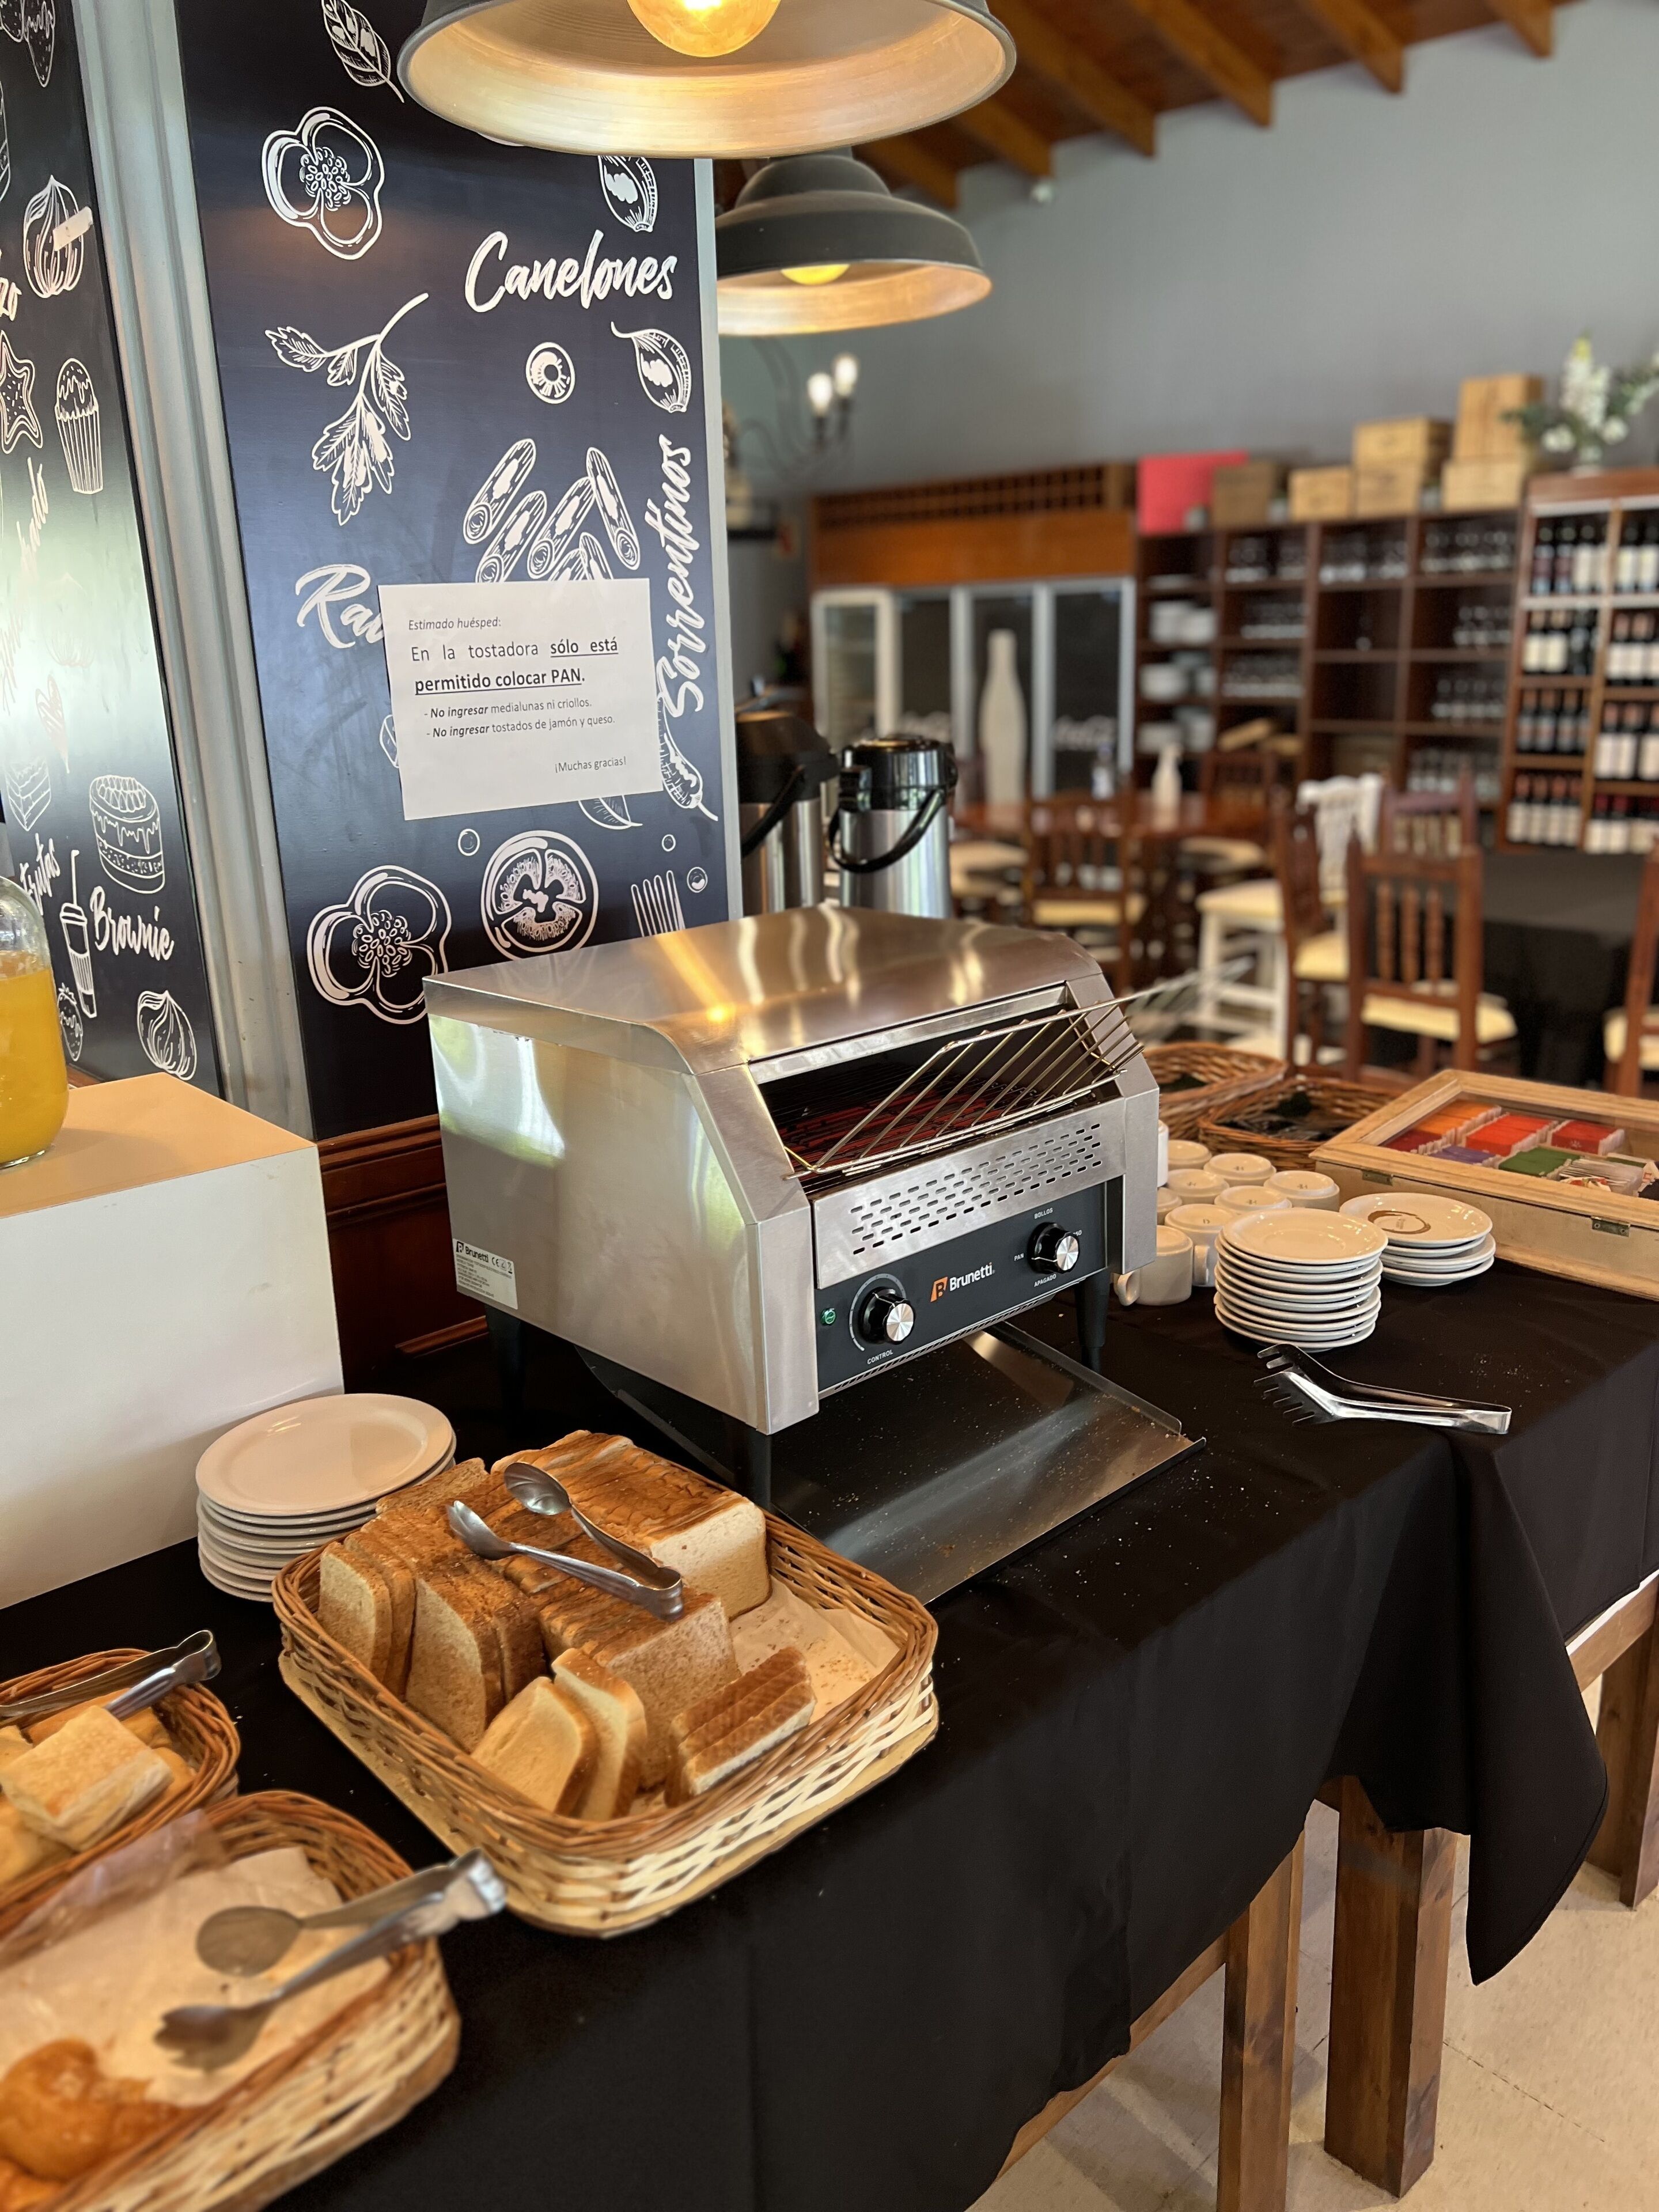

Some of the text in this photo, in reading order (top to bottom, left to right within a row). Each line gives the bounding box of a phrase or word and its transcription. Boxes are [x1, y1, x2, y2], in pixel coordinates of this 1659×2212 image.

[465, 229, 678, 313] Canelones
[644, 433, 707, 719] Sorrentinos
[408, 617, 501, 630] Estimado huésped:
[411, 636, 618, 661] En la tostadora sólo está
[415, 668, 585, 695] permitido colocar PAN.
[430, 697, 592, 719] No ingresar medialunas ni criollos.
[433, 715, 615, 738] No ingresar tostados de jamón y queso.
[555, 756, 627, 773] ¡Muchas gracias!
[90, 886, 175, 961] Brownie
[1034, 1208, 1054, 1219] BOLLOS
[1014, 1253, 1024, 1261] PAN
[949, 1262, 993, 1291] Brunetti
[1034, 1274, 1056, 1287] APAGADO
[867, 1349, 893, 1365] CONTROL
